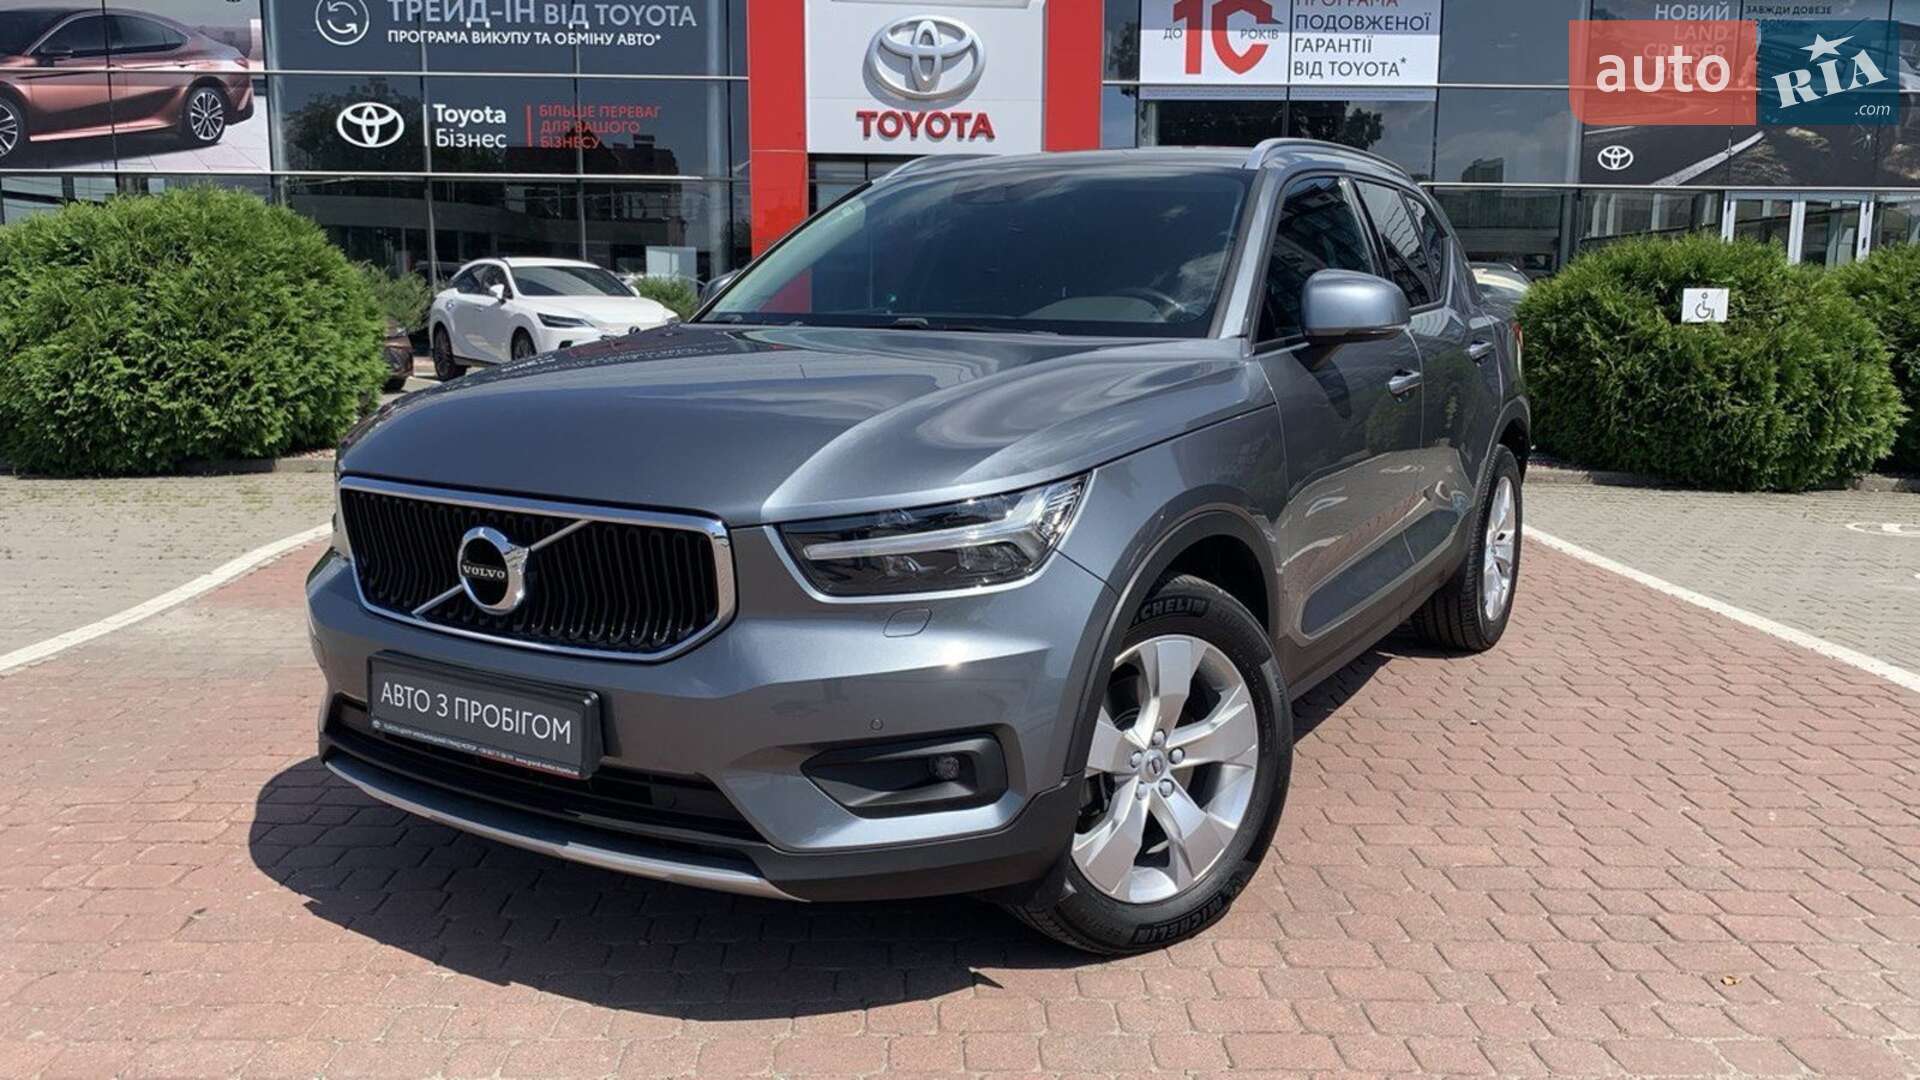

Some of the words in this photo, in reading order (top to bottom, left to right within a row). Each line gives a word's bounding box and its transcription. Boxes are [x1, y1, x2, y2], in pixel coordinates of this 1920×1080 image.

[544, 3, 589, 29] ВІД
[595, 4, 697, 27] TOYOTA
[1655, 2, 1730, 20] НОВИЙ
[1295, 12, 1432, 33] ПОДОВЖЕНОЇ
[387, 30, 469, 43] ПРОГРАМА
[472, 31, 532, 44] ВИКУПУ
[534, 32, 551, 44] ТА
[554, 32, 614, 45] ОБМІНУ
[1163, 28, 1183, 40] ДО
[1240, 28, 1279, 40] РОКІВ
[1294, 35, 1374, 53] ГАРАНТІЇ
[1294, 61, 1323, 79] ВІД
[433, 104, 506, 128] Toyota
[538, 105, 595, 118] БІЛЬШЕ
[600, 106, 662, 118] ПЕРЕВАГ
[540, 121, 574, 133] ДЛЯ
[576, 121, 640, 134] ВАШОГО
[856, 110, 995, 141] TOYOTA
[436, 128, 507, 148] Бізнес
[540, 135, 600, 149] БІЗНЕСУ
[462, 564, 506, 579] VOLVO
[380, 681, 431, 713] АВТО
[454, 696, 572, 745] ПРОБІГОМ
